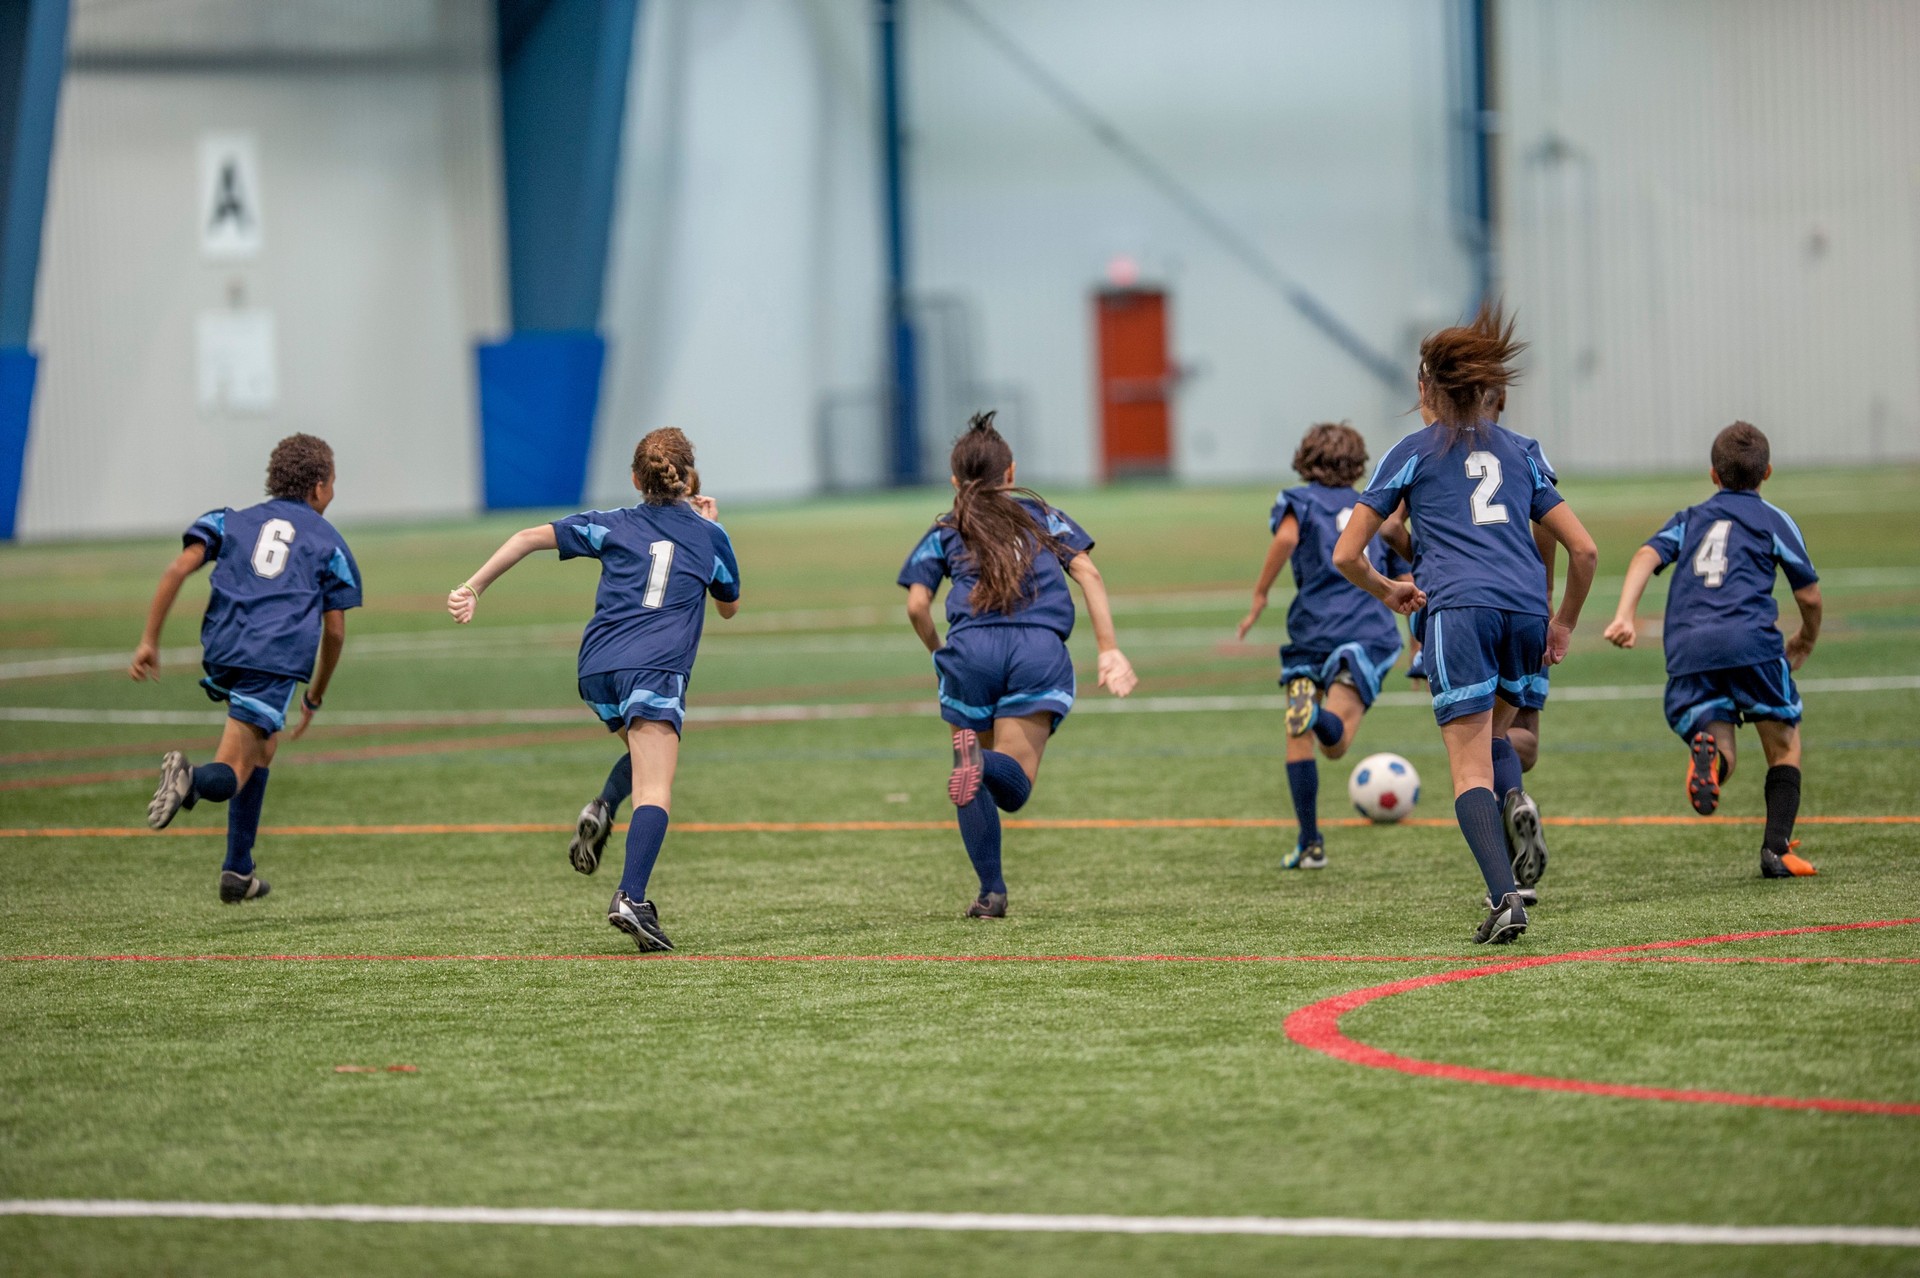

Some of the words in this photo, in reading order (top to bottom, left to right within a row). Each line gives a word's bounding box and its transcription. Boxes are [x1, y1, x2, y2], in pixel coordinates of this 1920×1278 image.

[207, 157, 257, 236] A
[1464, 451, 1510, 526] 2
[251, 518, 296, 580] 6
[642, 540, 674, 609] 1
[1693, 520, 1732, 588] 4
